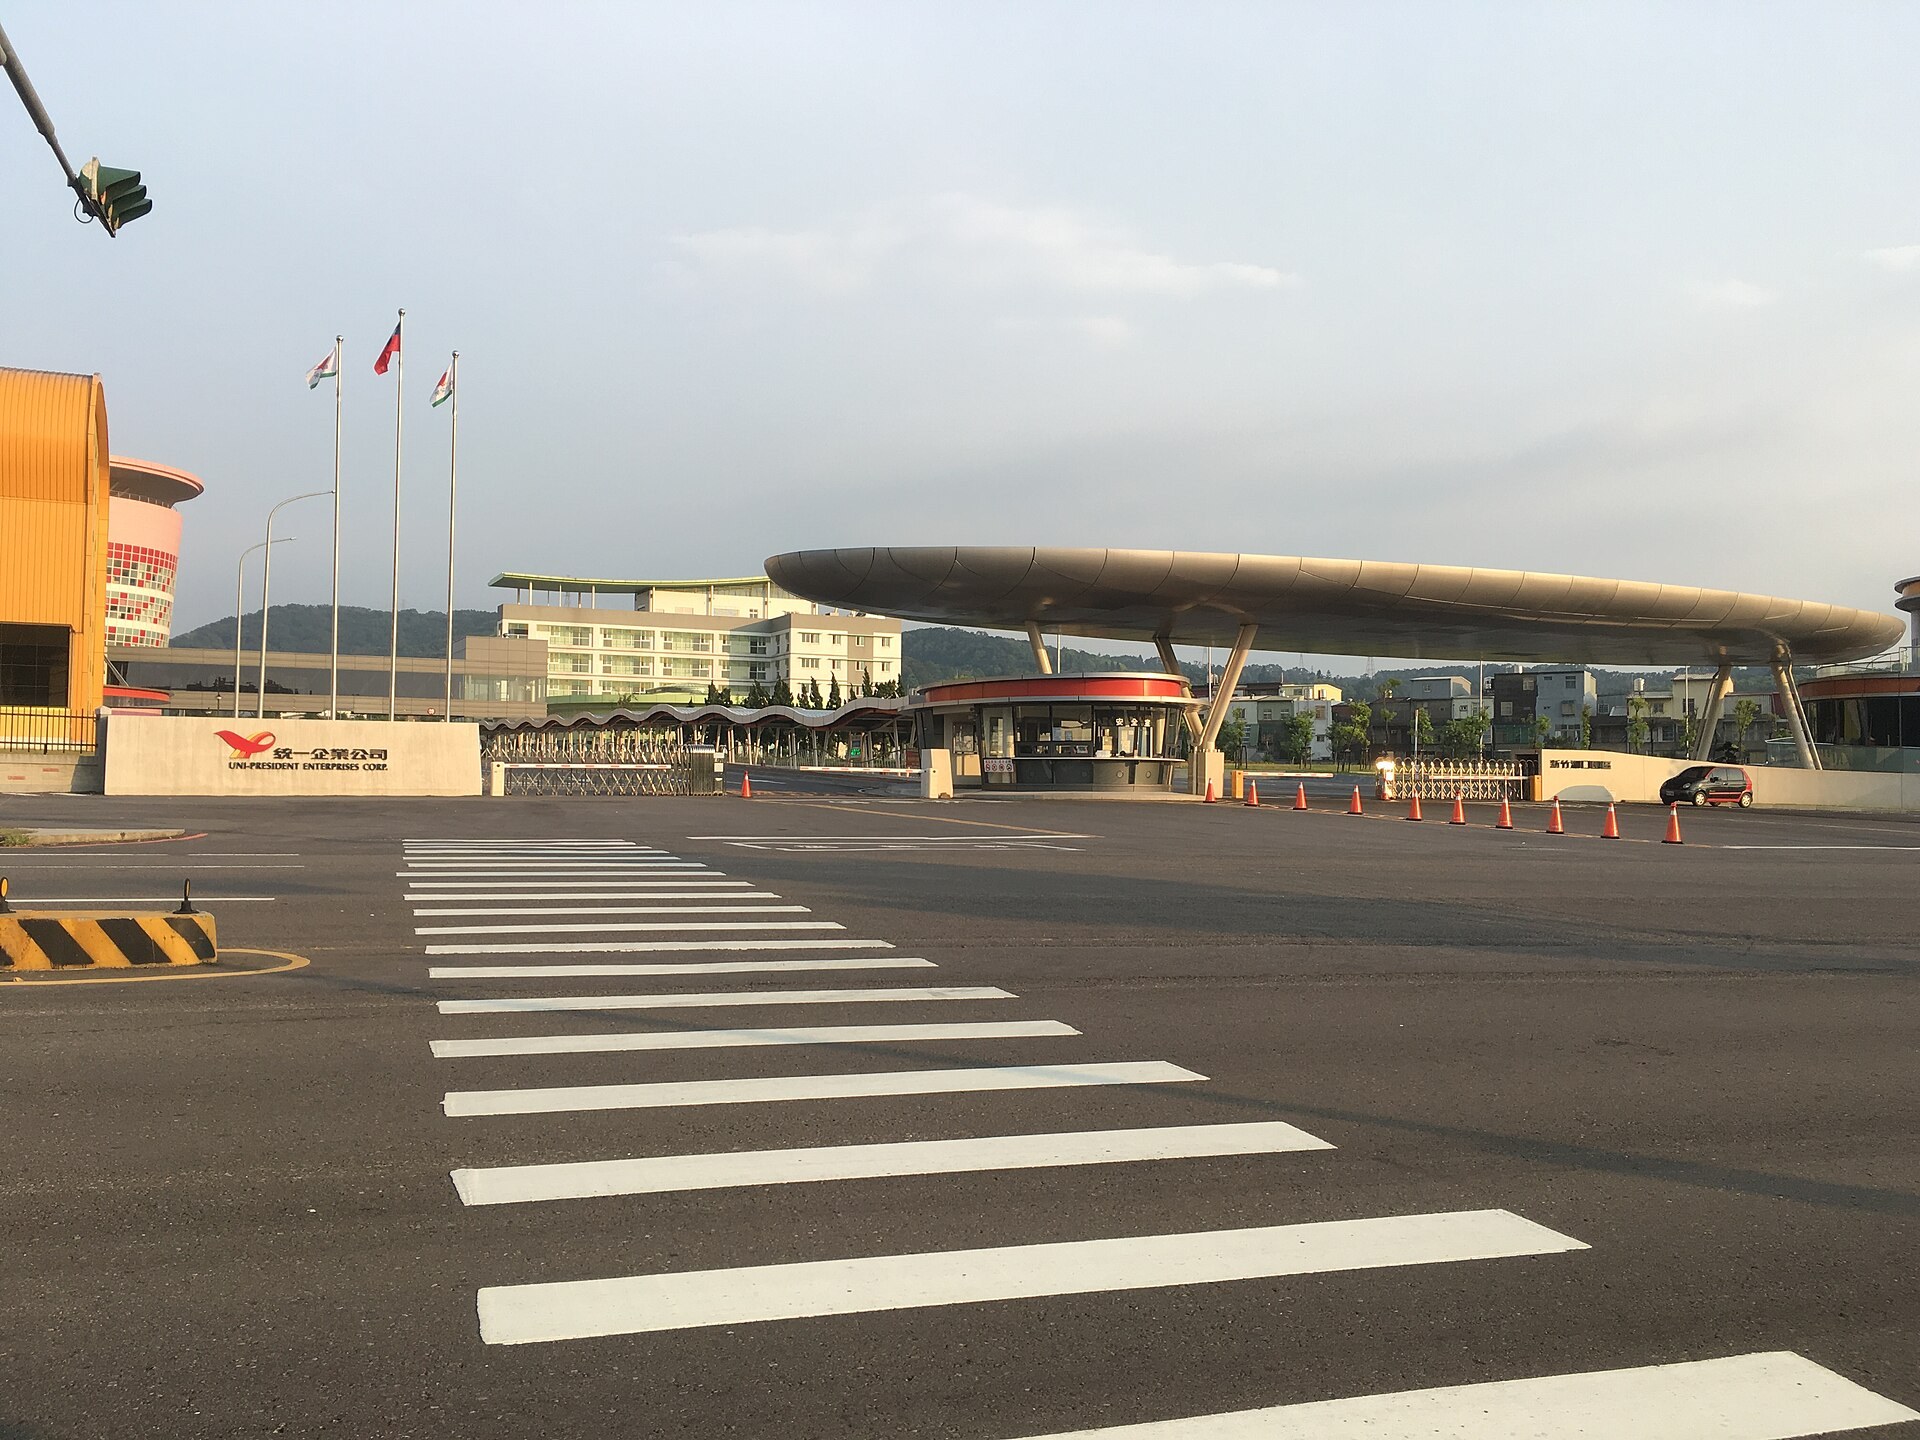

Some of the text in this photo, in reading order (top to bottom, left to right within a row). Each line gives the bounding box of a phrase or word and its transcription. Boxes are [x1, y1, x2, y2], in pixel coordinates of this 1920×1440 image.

[273, 748, 388, 760] 統一企業公司
[228, 762, 388, 771] UNI-PRESIDENT ENTERPRISES CORP.
